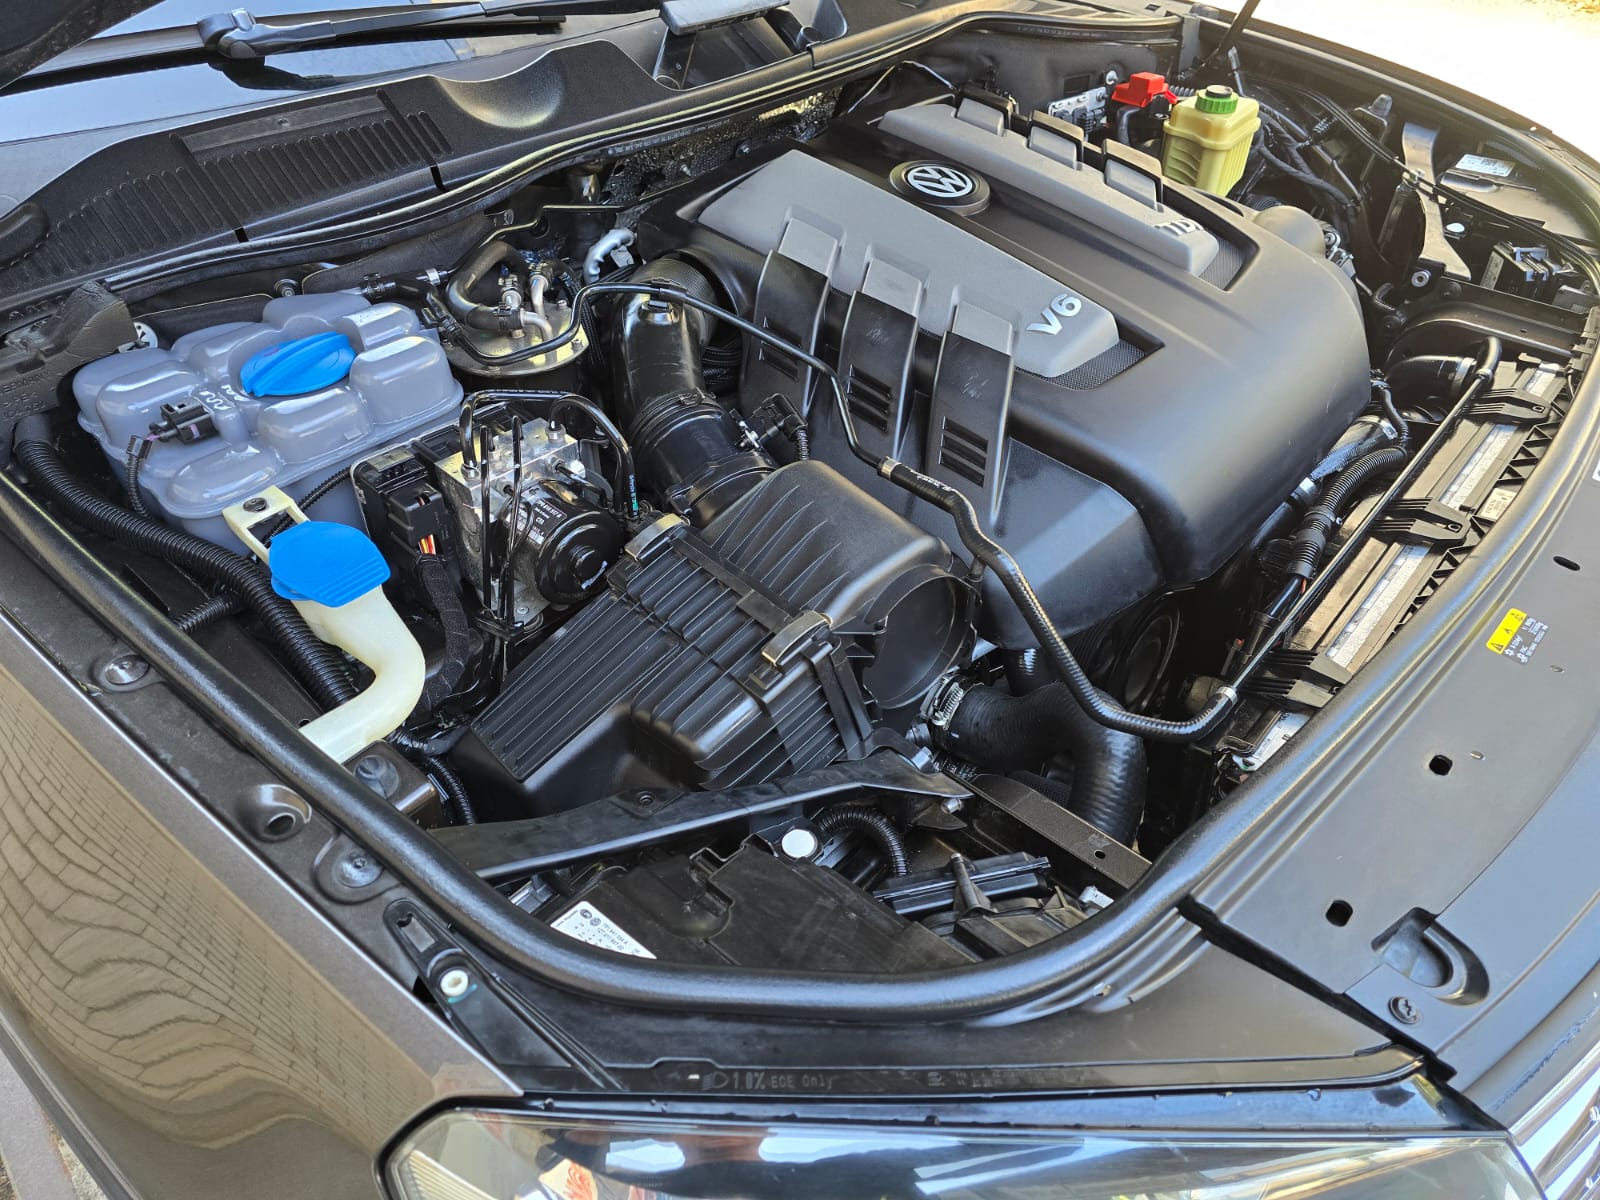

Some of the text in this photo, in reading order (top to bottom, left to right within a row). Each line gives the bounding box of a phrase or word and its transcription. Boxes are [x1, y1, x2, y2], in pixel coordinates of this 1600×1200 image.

[1154, 218, 1205, 236] TDI
[1026, 293, 1082, 335] V6
[733, 1071, 766, 1090] 1.0%
[801, 1074, 833, 1090] Only
